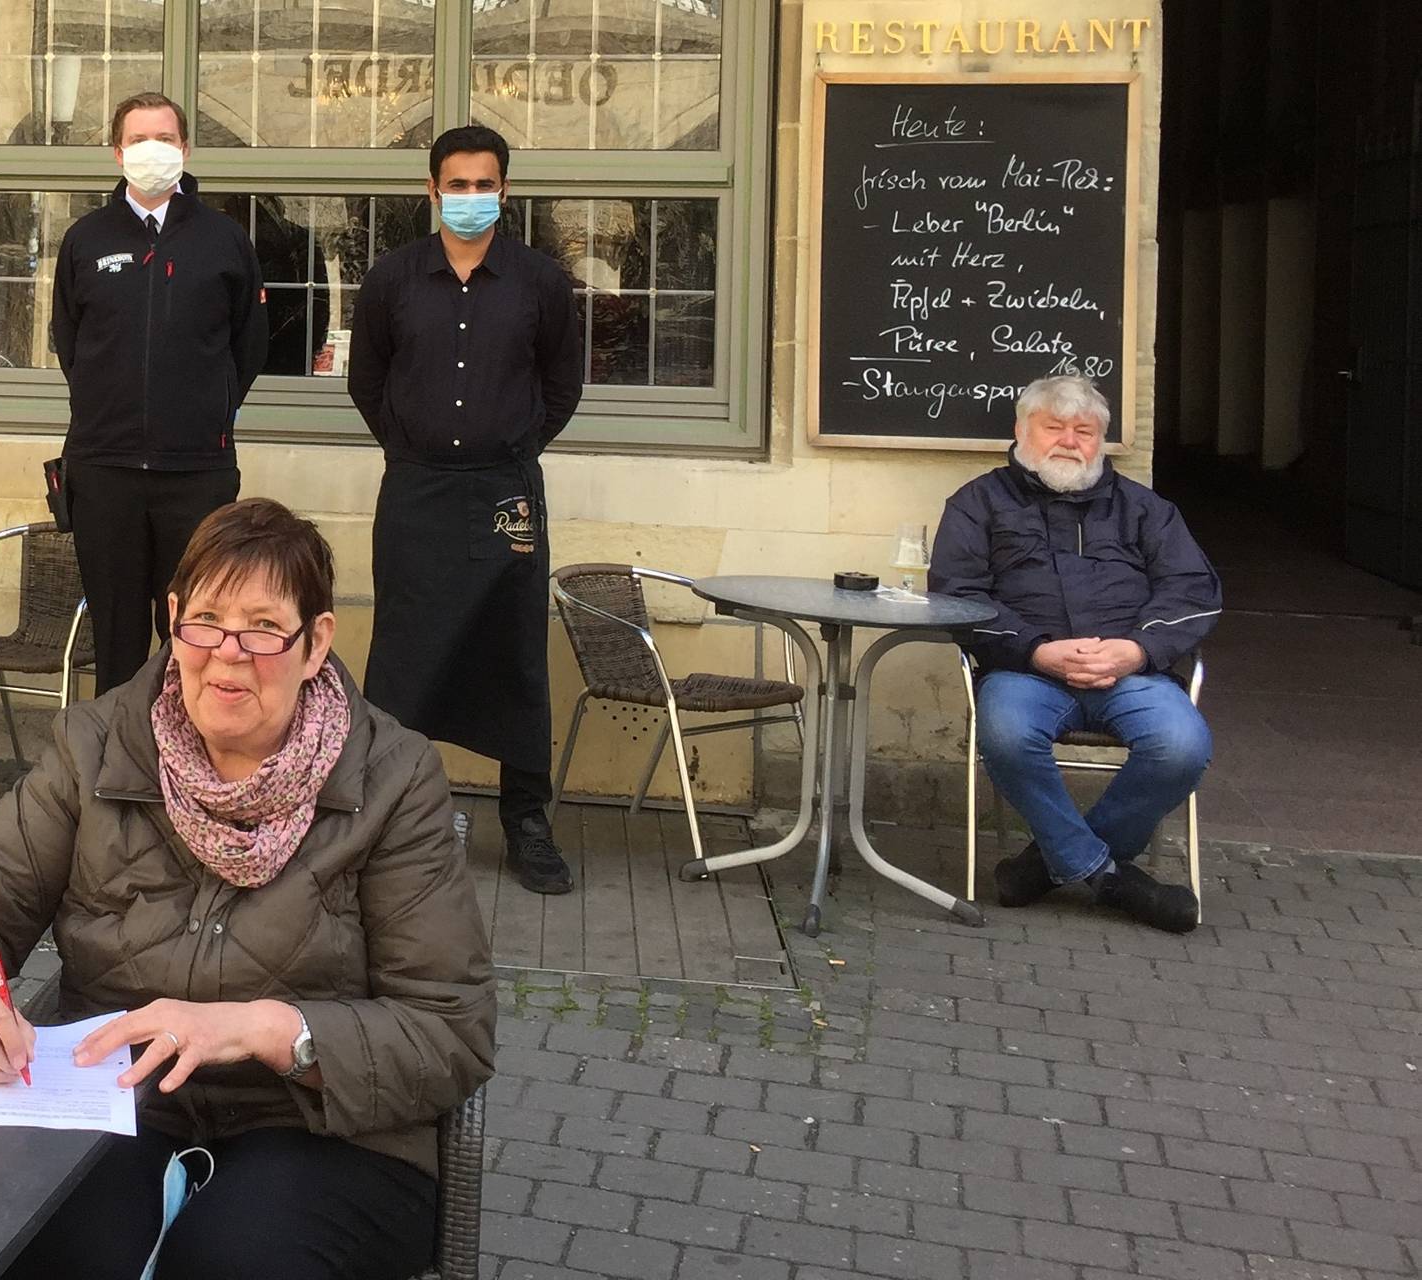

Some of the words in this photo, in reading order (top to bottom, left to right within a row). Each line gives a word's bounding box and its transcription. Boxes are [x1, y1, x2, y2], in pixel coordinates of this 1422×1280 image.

[815, 19, 1151, 54] RESTAURANT
[891, 104, 985, 139] Heute:
[854, 165, 927, 210] frisch
[939, 175, 987, 190] vom
[891, 210, 964, 234] Leber
[890, 247, 942, 267] mit
[951, 241, 1025, 273] Herz,
[986, 280, 1105, 321] Zwiebeln,
[991, 324, 1076, 356] Salate
